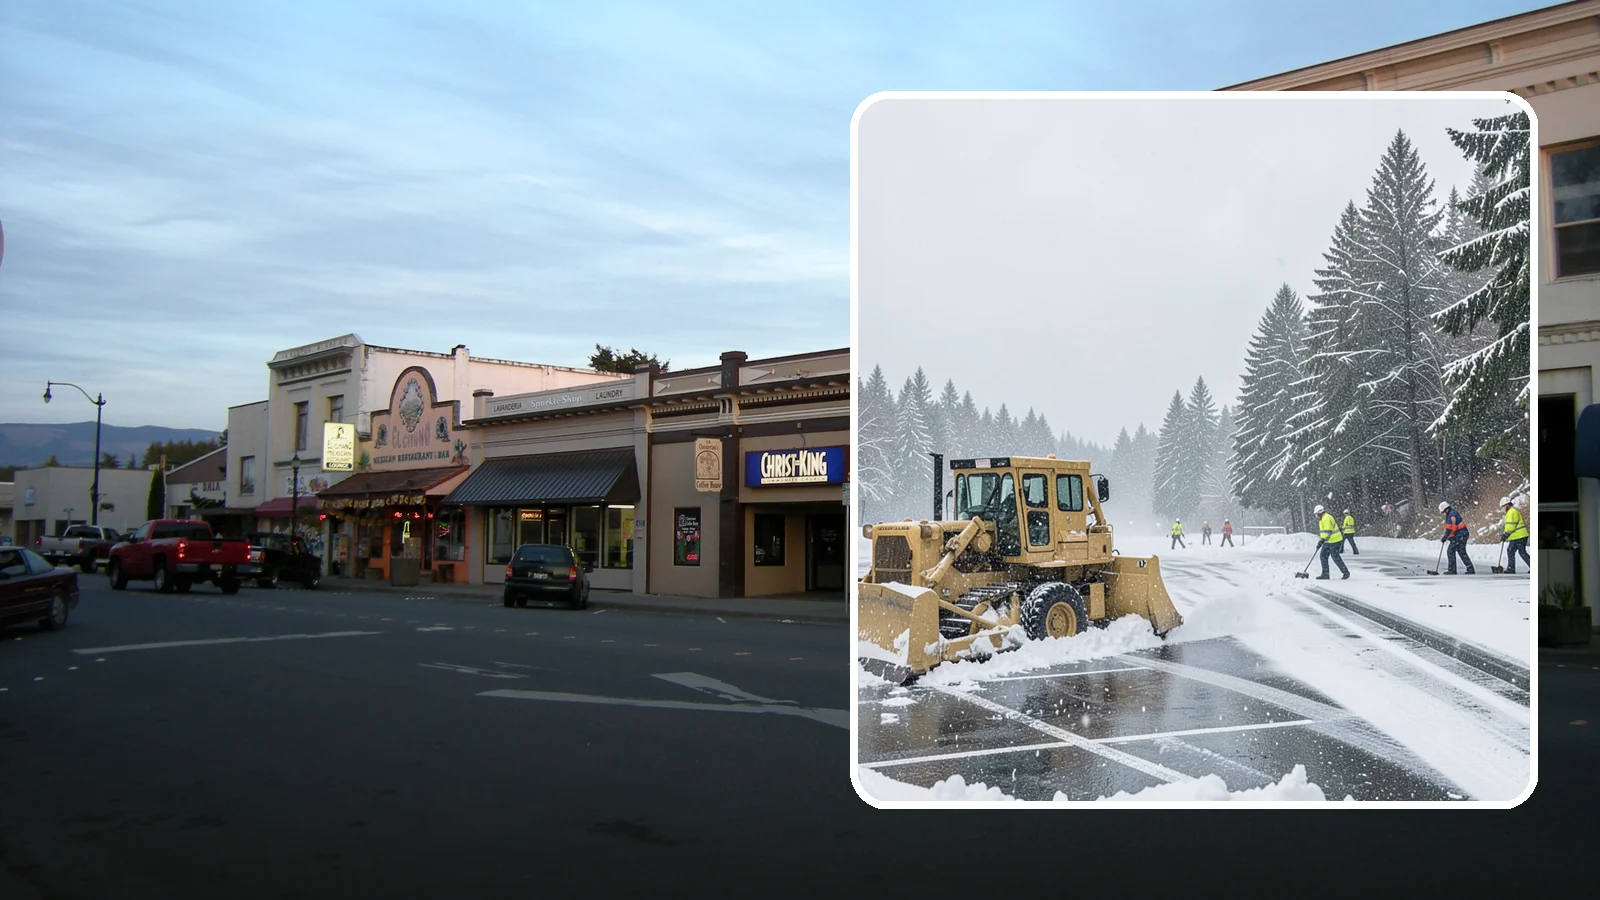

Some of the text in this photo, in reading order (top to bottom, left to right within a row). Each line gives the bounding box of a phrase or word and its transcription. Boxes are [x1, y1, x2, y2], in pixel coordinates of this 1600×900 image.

[595, 389, 623, 400] LAUNDRY
[493, 402, 523, 413] LAVANDERIA
[530, 394, 582, 409] Sparkle Shop
[392, 425, 402, 449] EL
[373, 455, 396, 463] MEXICAN
[397, 451, 434, 462] RESTAURANT
[438, 450, 450, 459] BAR
[696, 480, 709, 489] Coffee
